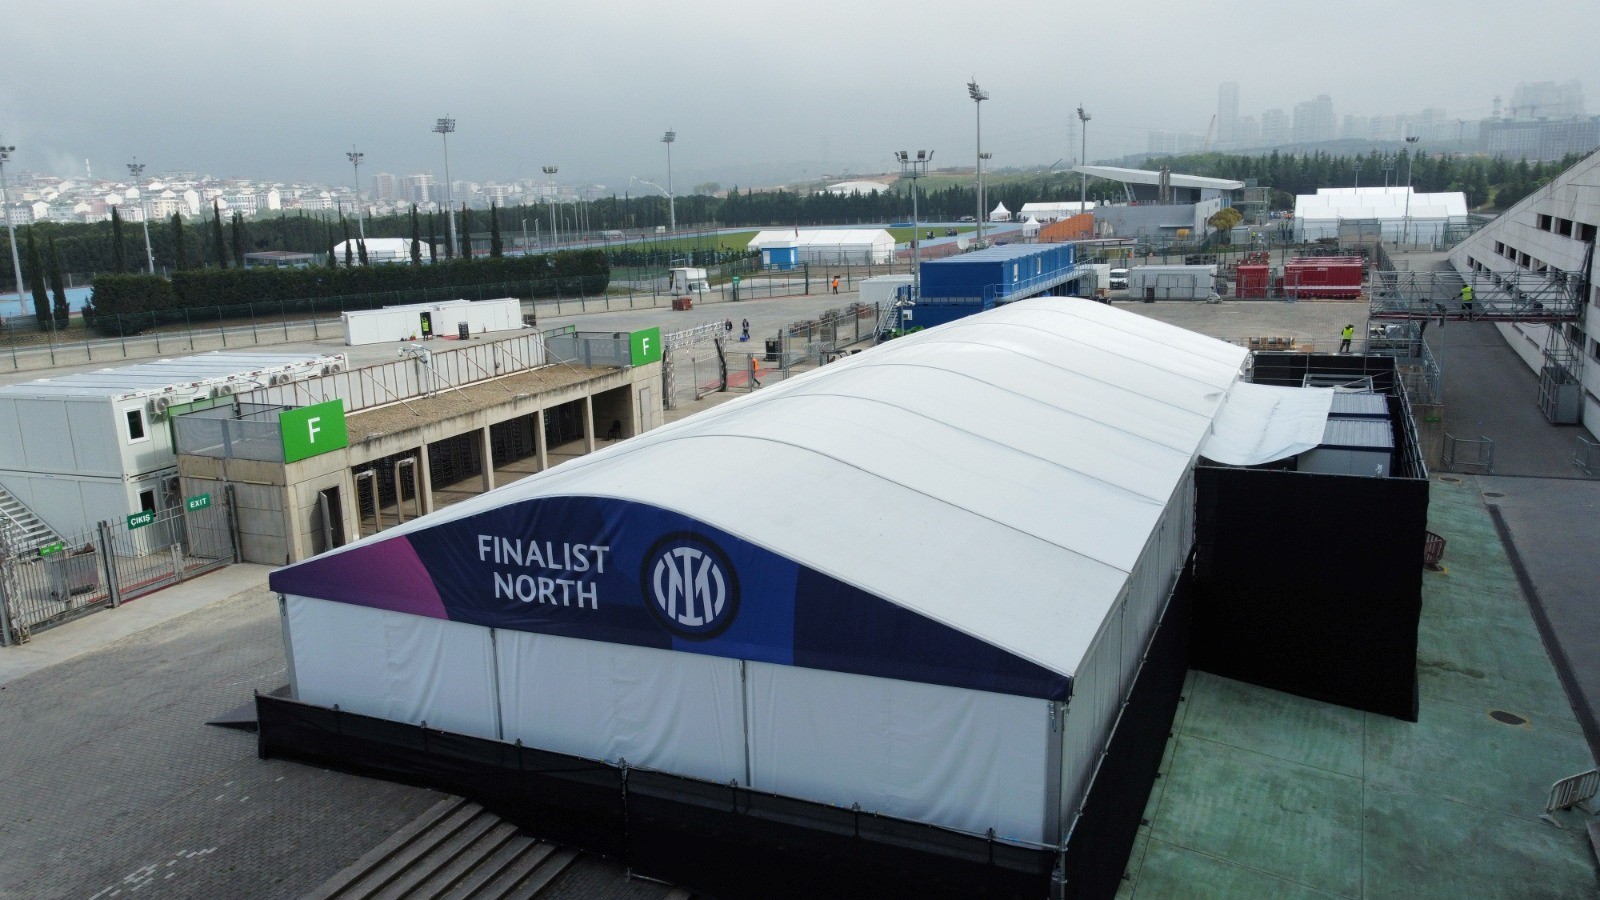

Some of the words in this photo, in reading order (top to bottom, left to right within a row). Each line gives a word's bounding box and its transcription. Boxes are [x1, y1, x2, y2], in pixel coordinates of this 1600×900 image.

[642, 337, 650, 356] F
[307, 416, 321, 444] F
[189, 497, 207, 508] EXIT
[130, 513, 151, 527] ÇIKIŞ
[477, 534, 610, 574] FINALIST
[493, 571, 598, 610] NORTH
